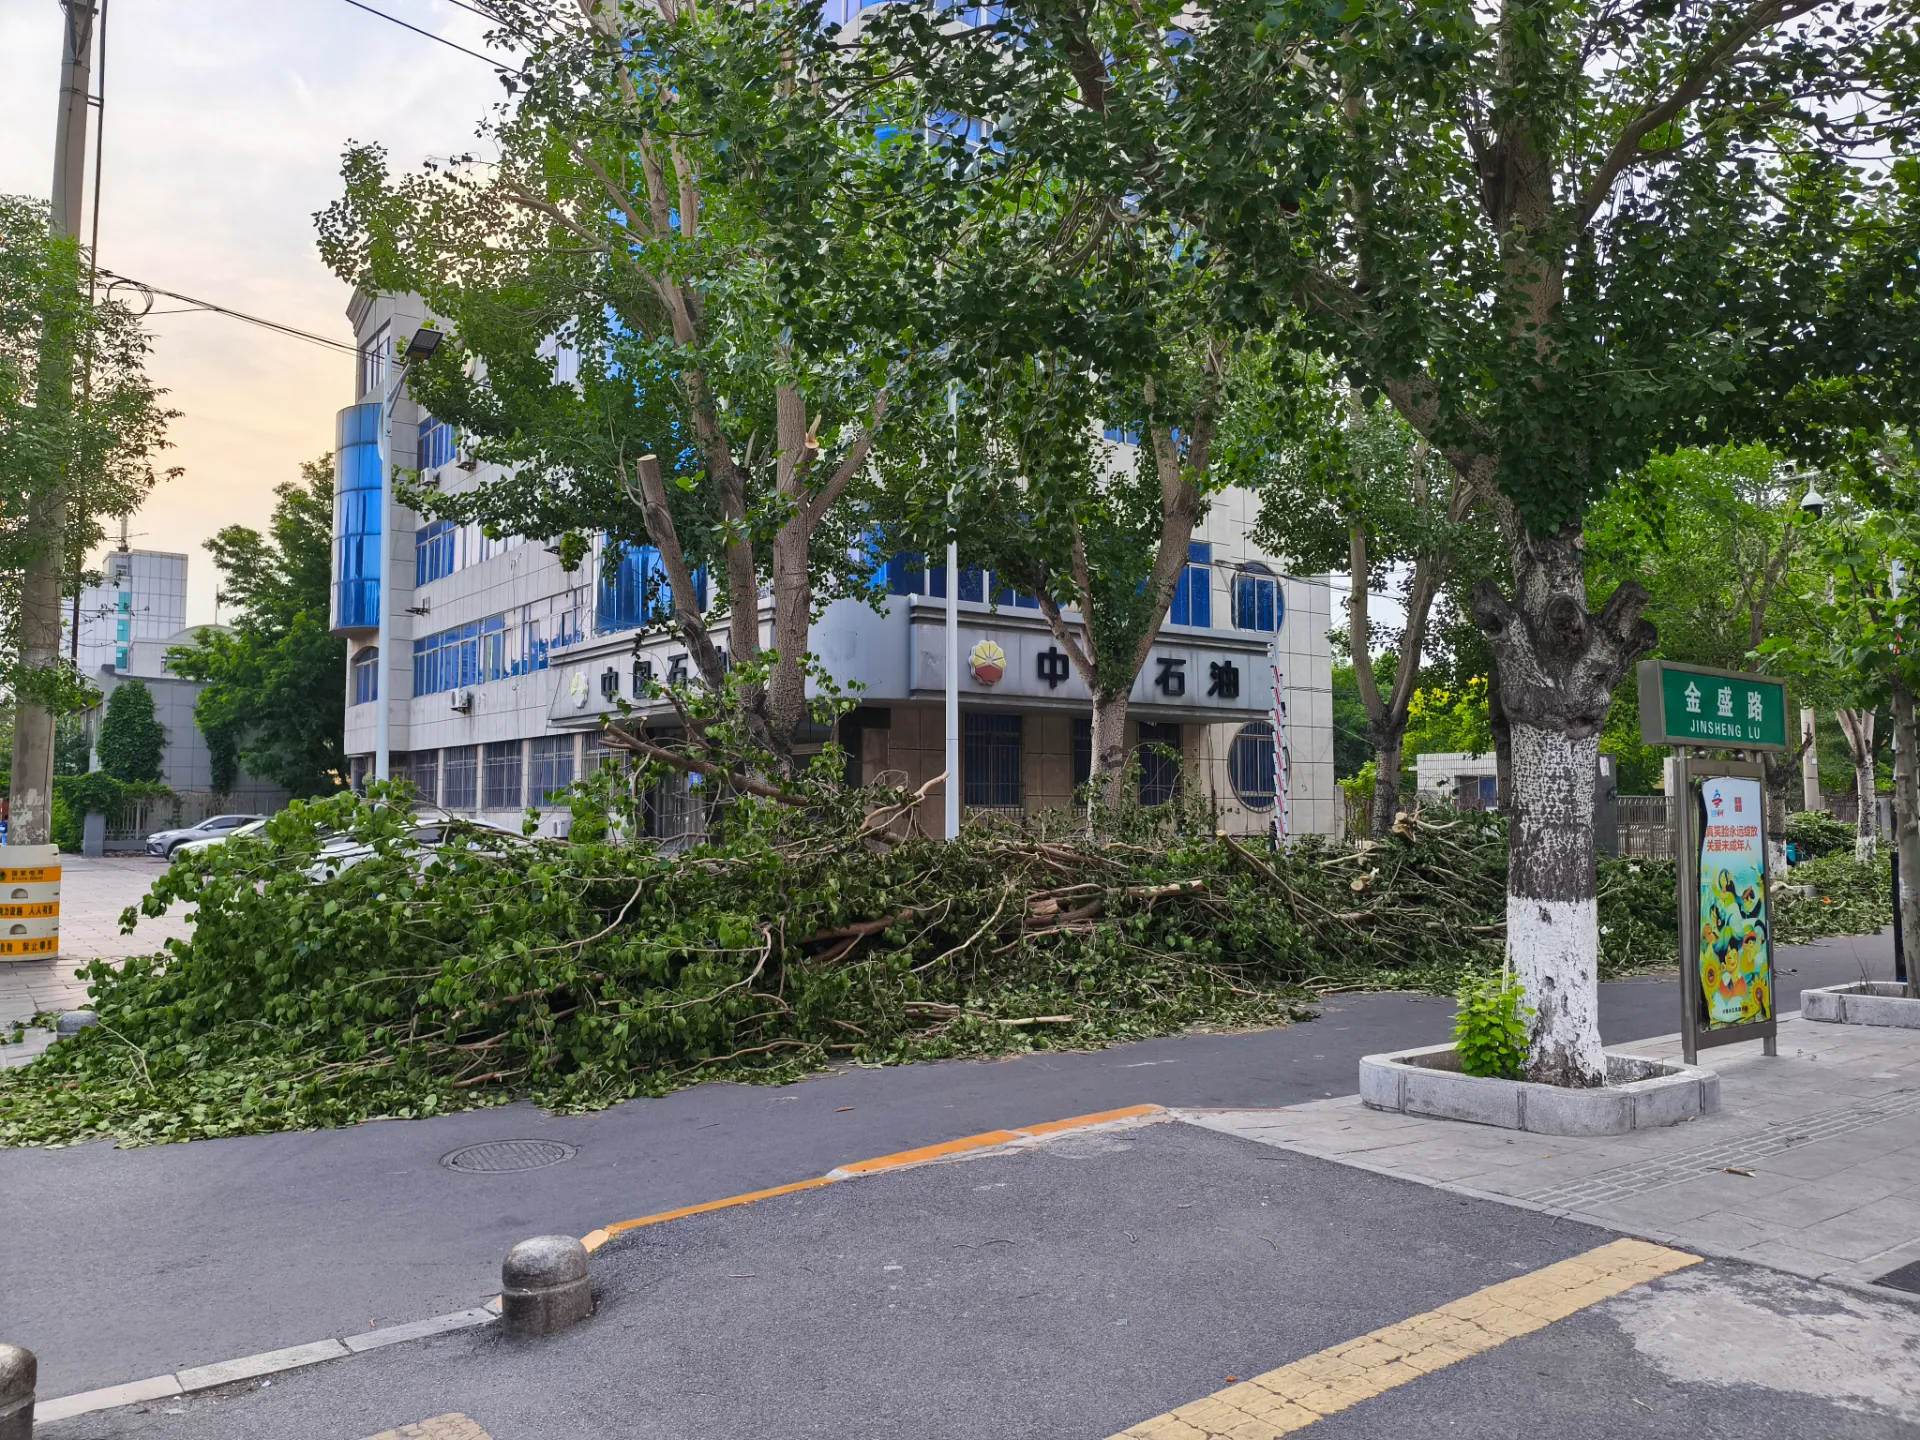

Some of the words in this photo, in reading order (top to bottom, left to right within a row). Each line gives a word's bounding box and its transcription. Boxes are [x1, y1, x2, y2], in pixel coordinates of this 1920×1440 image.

[601, 646, 728, 703] 中国石
[1037, 646, 1240, 699] 中石油
[1684, 680, 1763, 722] 金盛路
[1690, 719, 1742, 738] JINSHENG
[1748, 726, 1761, 740] LU
[1705, 824, 1758, 838] 真笑脸永远绽放
[1706, 839, 1752, 852] 关爱未成年人
[29, 905, 53, 916] 人人有责
